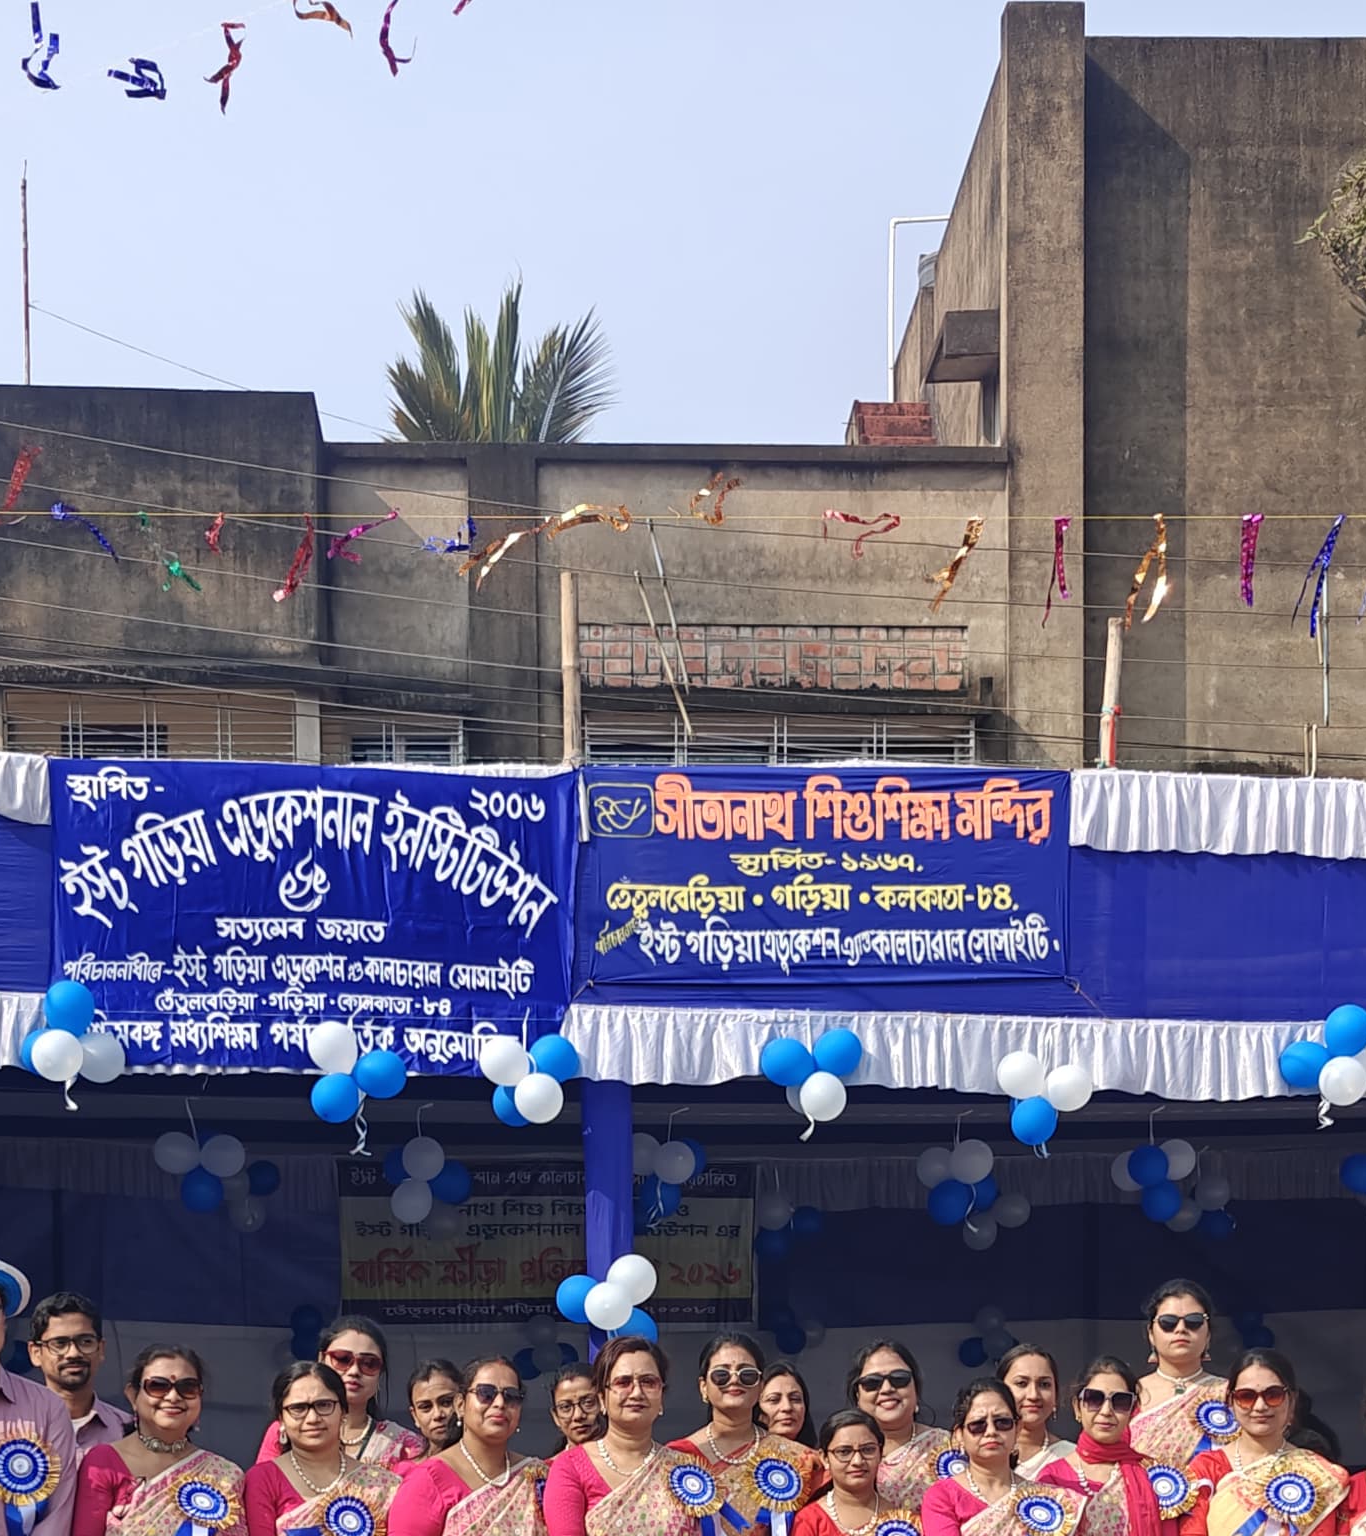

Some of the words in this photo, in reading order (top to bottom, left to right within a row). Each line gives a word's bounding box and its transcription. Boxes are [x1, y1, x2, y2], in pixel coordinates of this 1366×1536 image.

[468, 788, 546, 822] ২০০৬
[654, 772, 798, 842] সীতানাথ
[953, 777, 1055, 847] মন্দির
[121, 812, 218, 888] গড়িয়া
[216, 784, 380, 864] এডুকেশনাল
[771, 872, 852, 918] গড়িয়া
[215, 917, 307, 946] সত্যমেব
[316, 918, 388, 945] জয়তে
[686, 915, 763, 971] গড়িয়া
[213, 946, 268, 987] গড়িয়া
[449, 956, 535, 1001] সোসাইটি
[268, 988, 327, 1016] গড়িয়া
